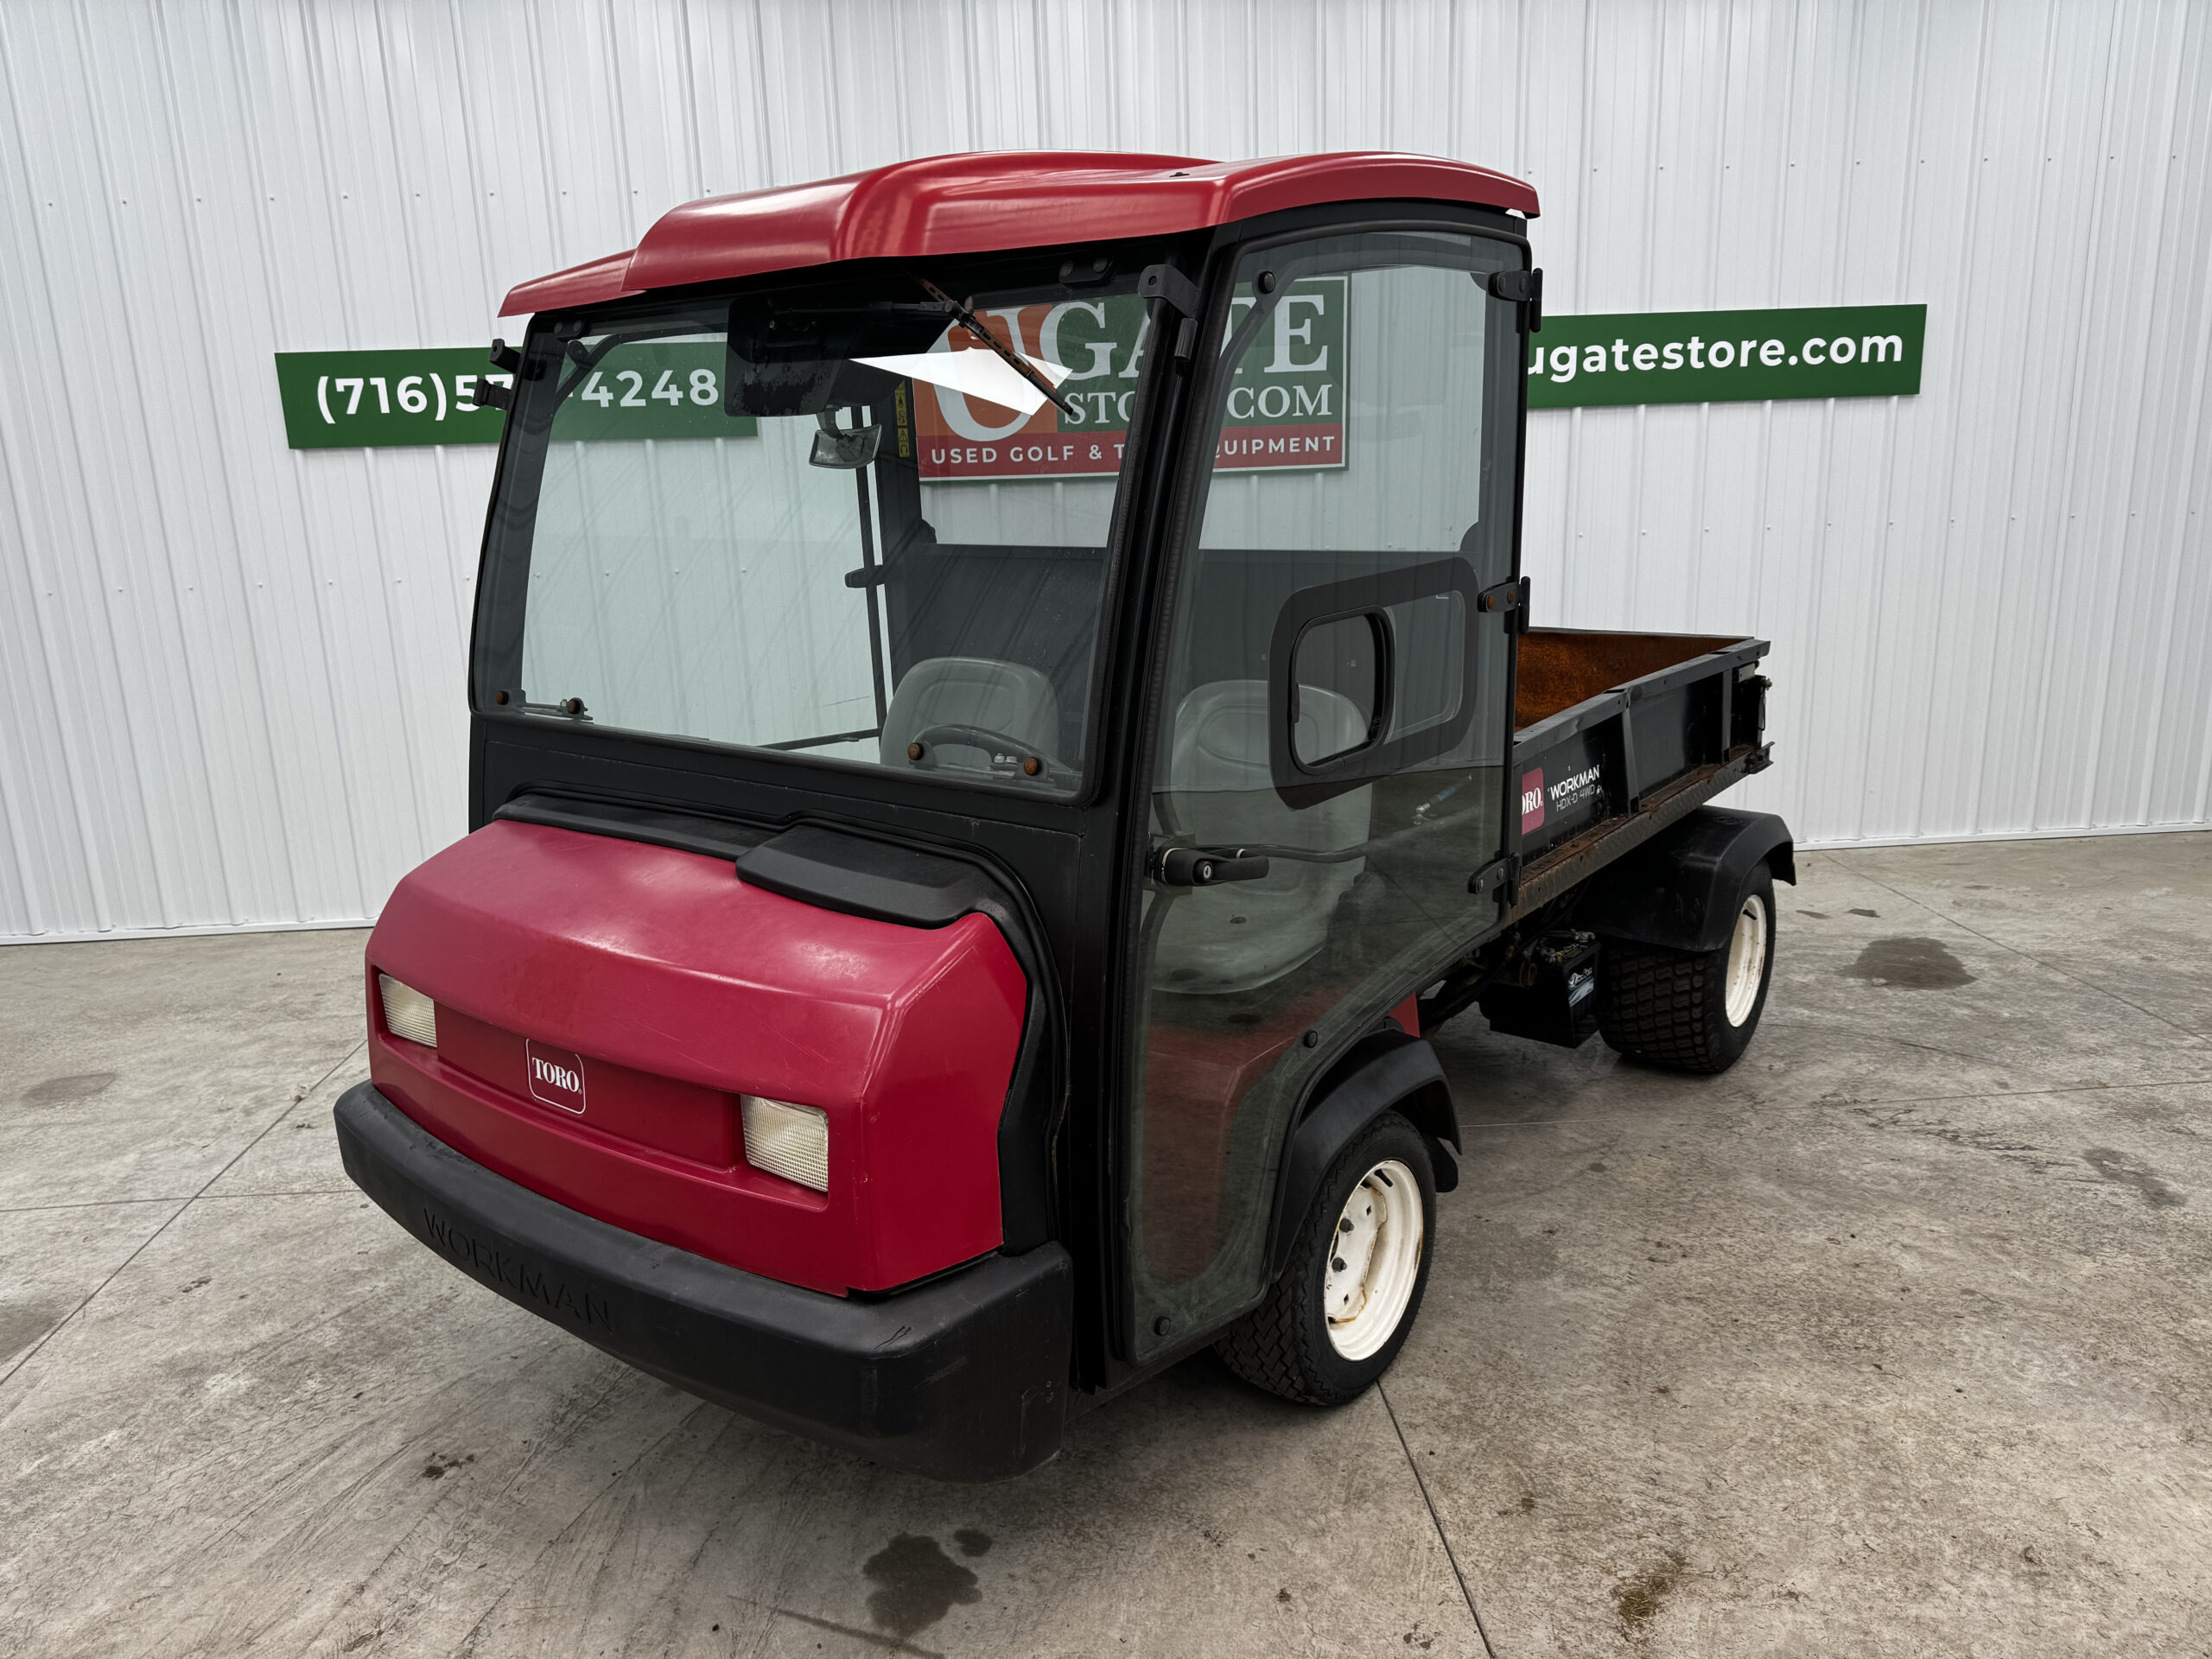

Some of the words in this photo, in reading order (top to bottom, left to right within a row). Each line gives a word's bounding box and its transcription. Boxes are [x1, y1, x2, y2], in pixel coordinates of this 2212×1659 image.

[931, 447, 997, 465] USED
[1009, 445, 1074, 462] GOLF
[1089, 443, 1103, 460] &
[1550, 764, 1599, 801] WORKMAN
[532, 1056, 581, 1093] TORO
[423, 1208, 613, 1335] WORKMAN
